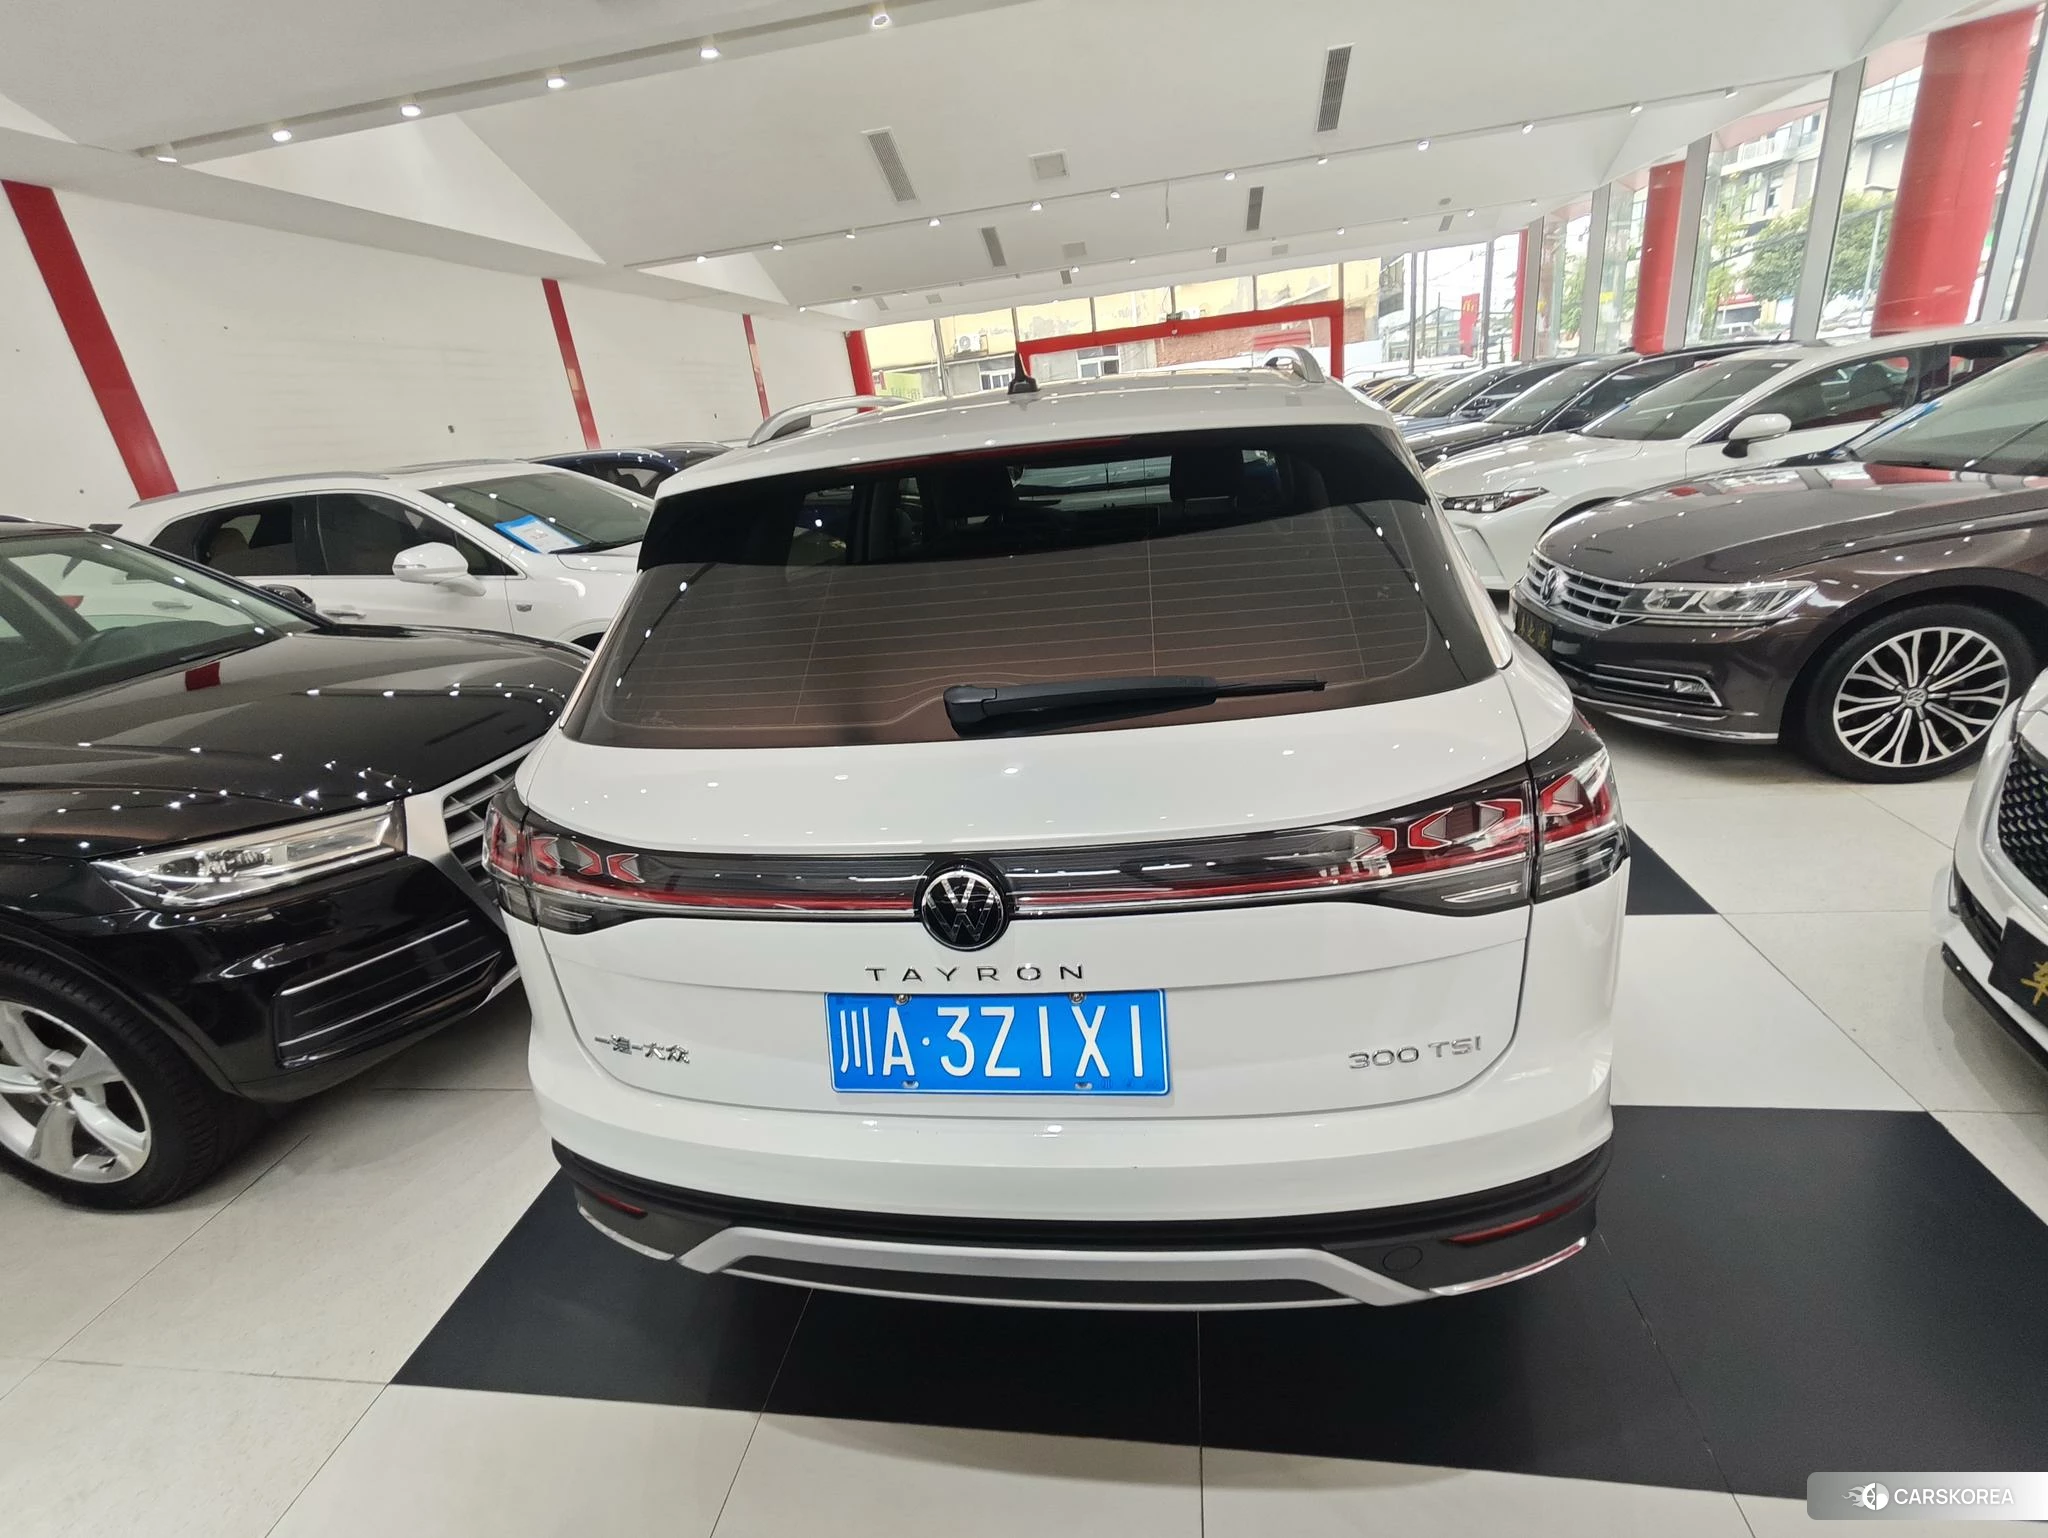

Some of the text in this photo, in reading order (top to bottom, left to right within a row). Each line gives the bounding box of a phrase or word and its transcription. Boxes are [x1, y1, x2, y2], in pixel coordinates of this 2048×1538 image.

[865, 963, 1084, 982] TAYRON
[1348, 1035, 1481, 1070] 300 TSI
